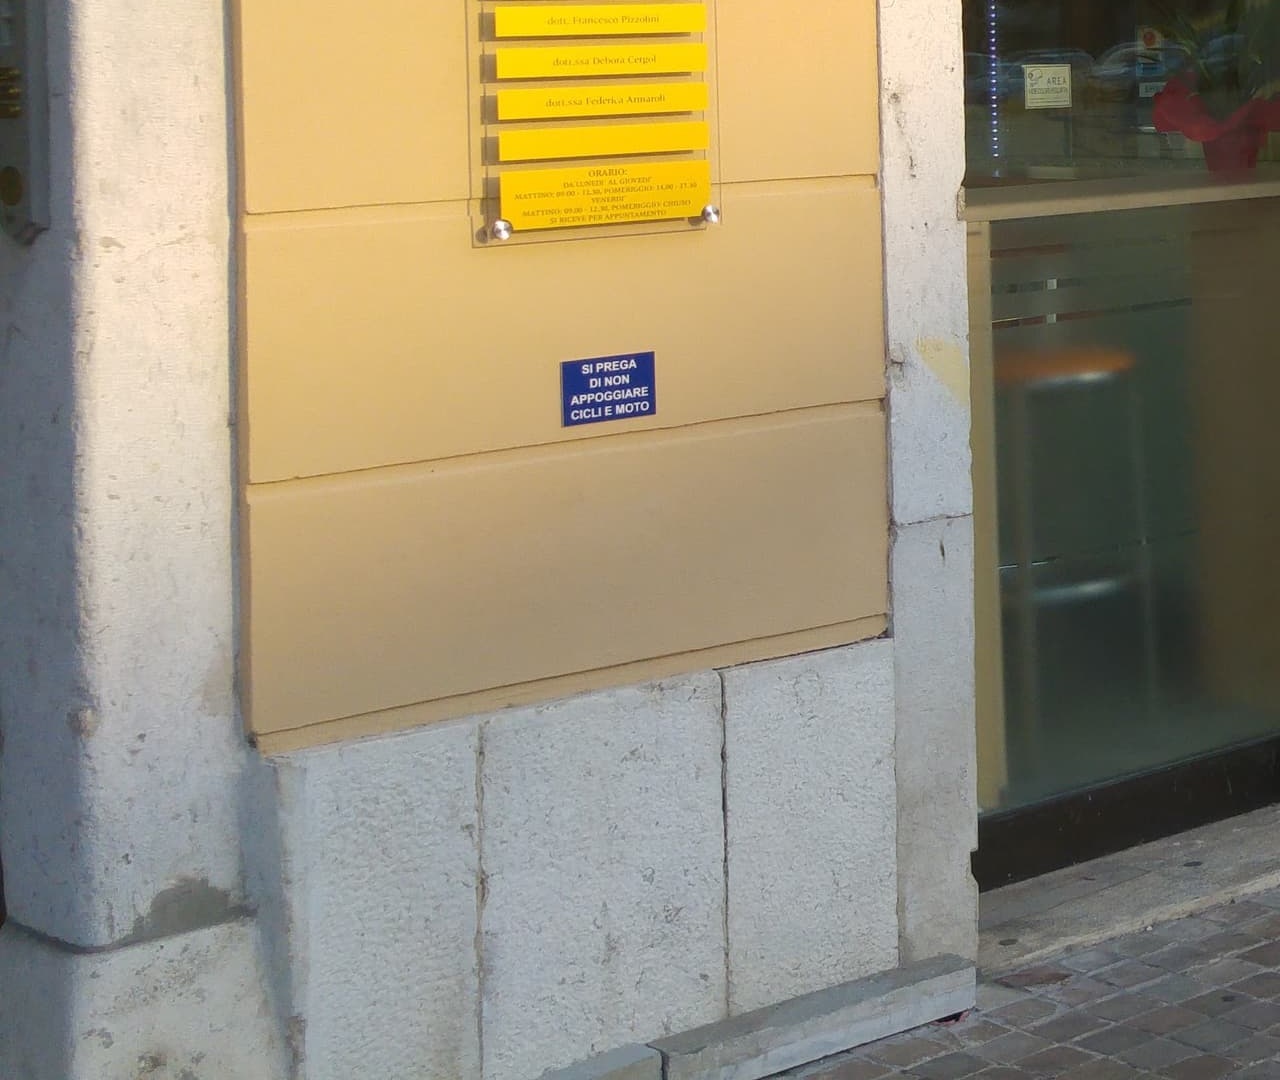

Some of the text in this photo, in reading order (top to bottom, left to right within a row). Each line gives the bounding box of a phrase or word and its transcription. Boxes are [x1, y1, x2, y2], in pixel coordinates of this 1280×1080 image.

[573, 15, 619, 25] Francesco
[592, 55, 625, 65] Debora
[586, 96, 623, 106] Federica
[588, 168, 628, 178] ORARIO:
[582, 359, 637, 375] SI PREGA
[589, 374, 630, 389] DI NON
[570, 386, 649, 406] APPOGGIARE
[570, 401, 650, 420] CICLI E MOTO
